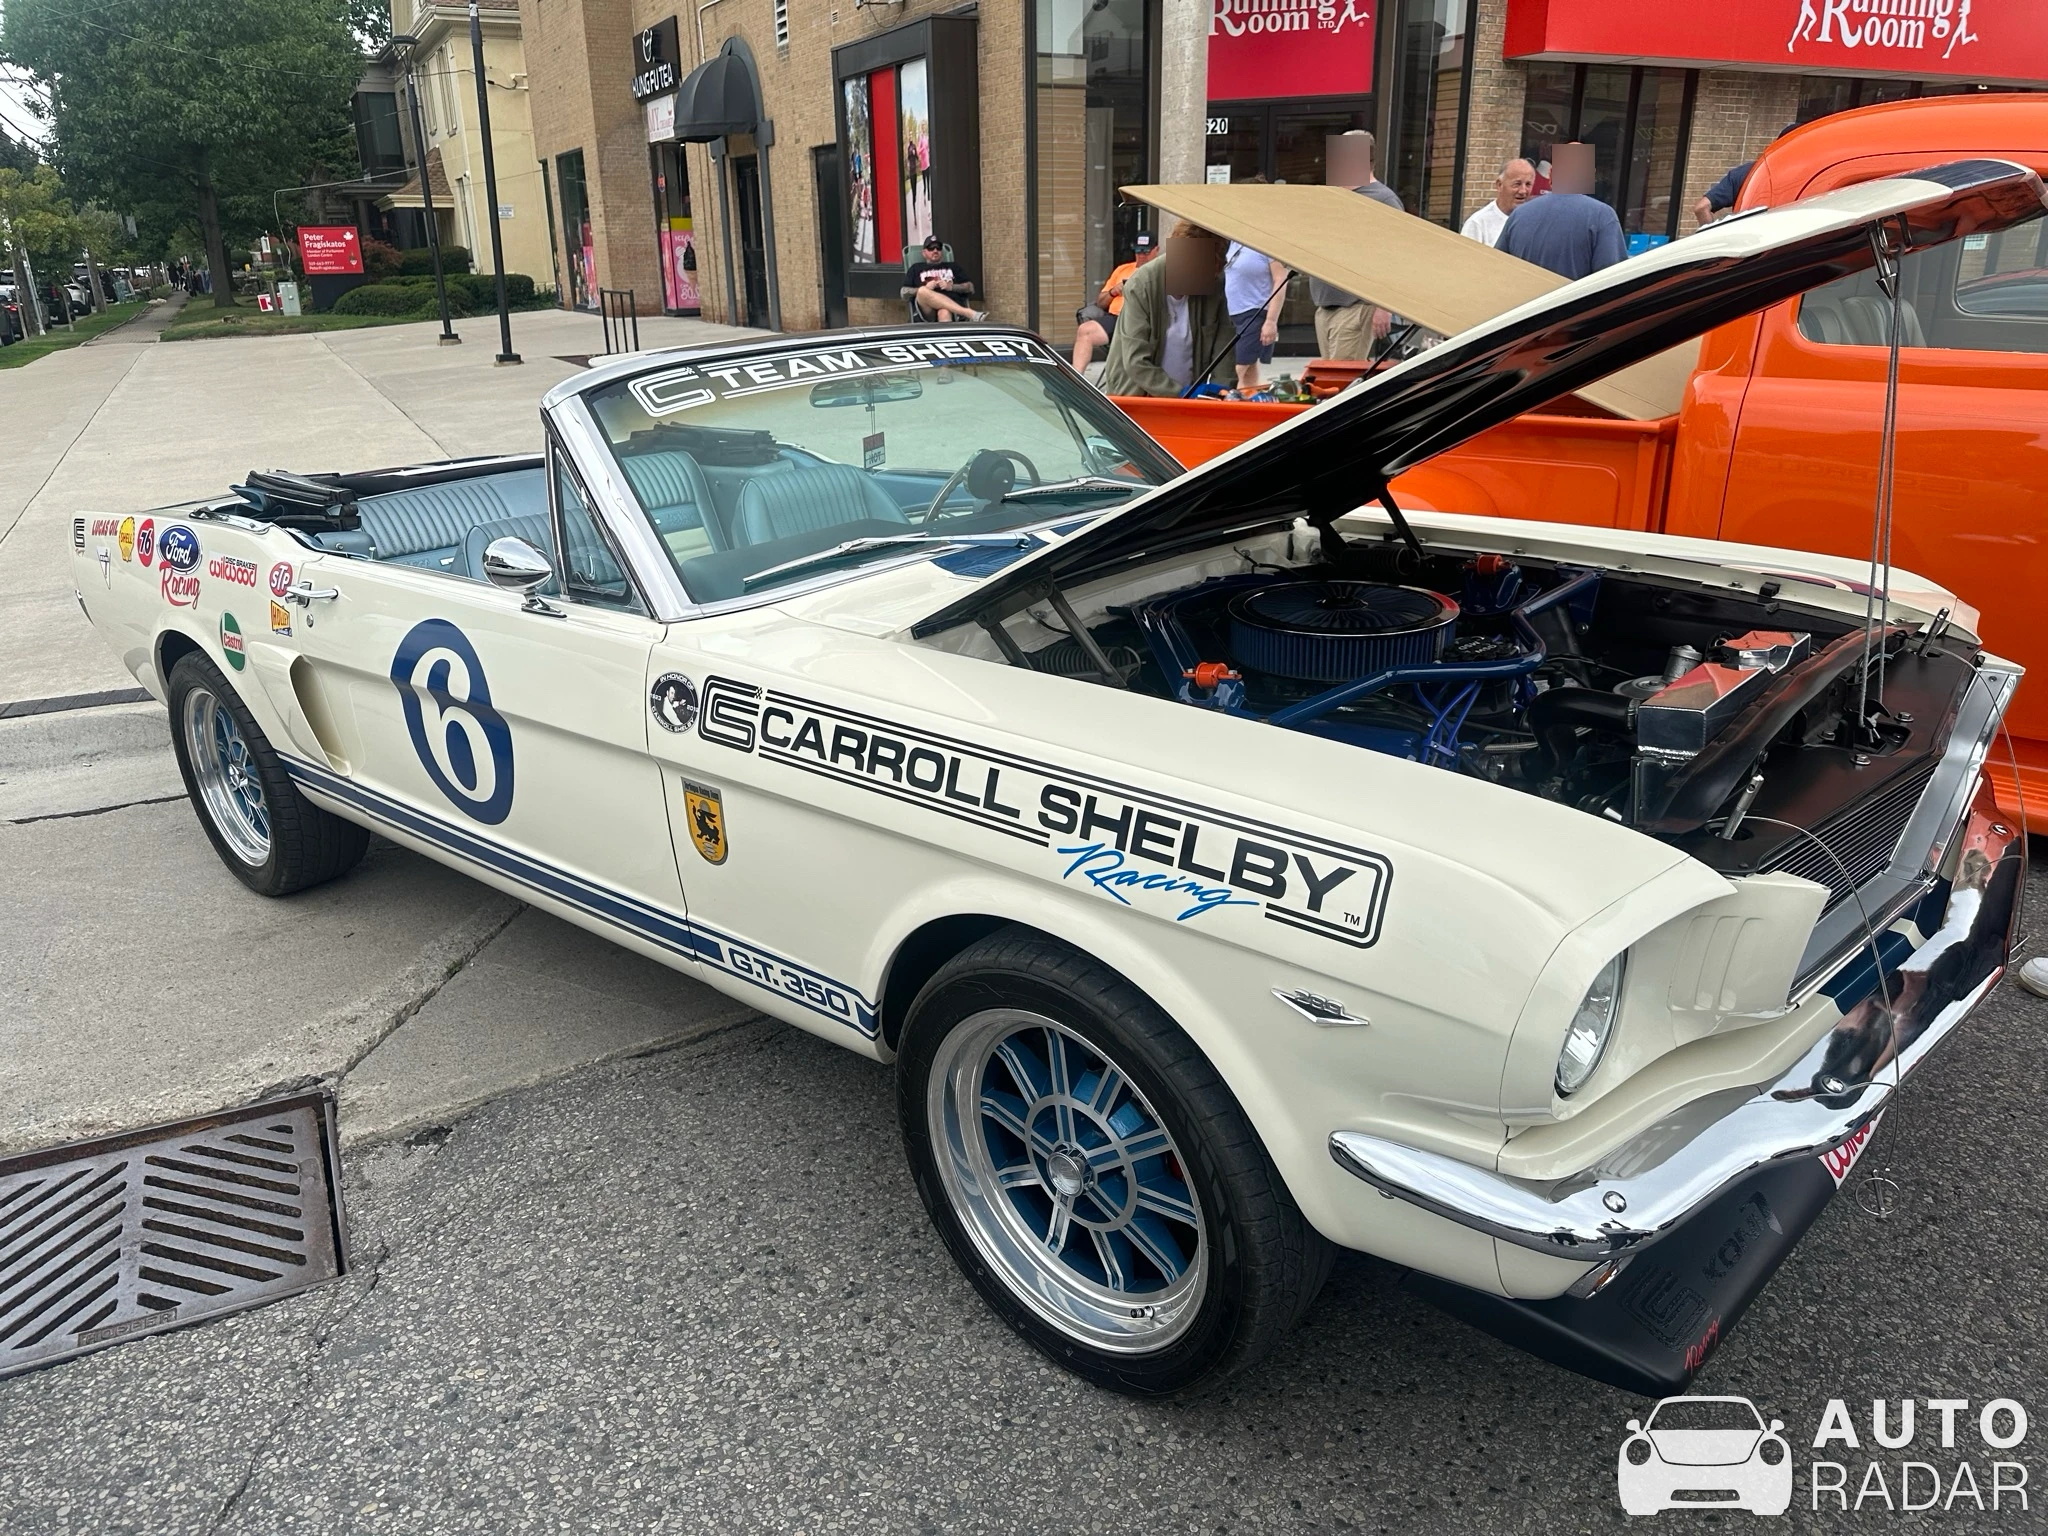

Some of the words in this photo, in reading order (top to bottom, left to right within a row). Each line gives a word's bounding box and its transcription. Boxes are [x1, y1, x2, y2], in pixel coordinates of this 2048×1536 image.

[303, 233, 324, 241] Peter
[305, 240, 346, 249] Fragiskatos
[707, 350, 868, 389] TEAM
[881, 341, 1034, 363] SHELBY
[91, 519, 109, 536] LUCAS
[120, 532, 133, 545] SHELL
[140, 528, 153, 555] 76
[165, 531, 192, 565] Ford
[209, 556, 257, 588] wilwood
[225, 557, 236, 565] DISC
[236, 559, 256, 571] BRAKES
[158, 560, 201, 610] Racing
[271, 564, 290, 592] STP
[223, 632, 243, 652] Castrol
[660, 675, 667, 683] IN
[666, 673, 687, 684] HONOR
[686, 681, 695, 690] OF
[406, 642, 499, 808] 6
[651, 705, 674, 731] CARROLL
[673, 717, 695, 732] SHELBY
[760, 706, 1020, 819] CARROLL
[1037, 784, 1357, 913] SHELBY
[1057, 843, 1260, 921] Racing
[1343, 912, 1361, 926] TM
[1684, 1315, 1722, 1376] Racing
